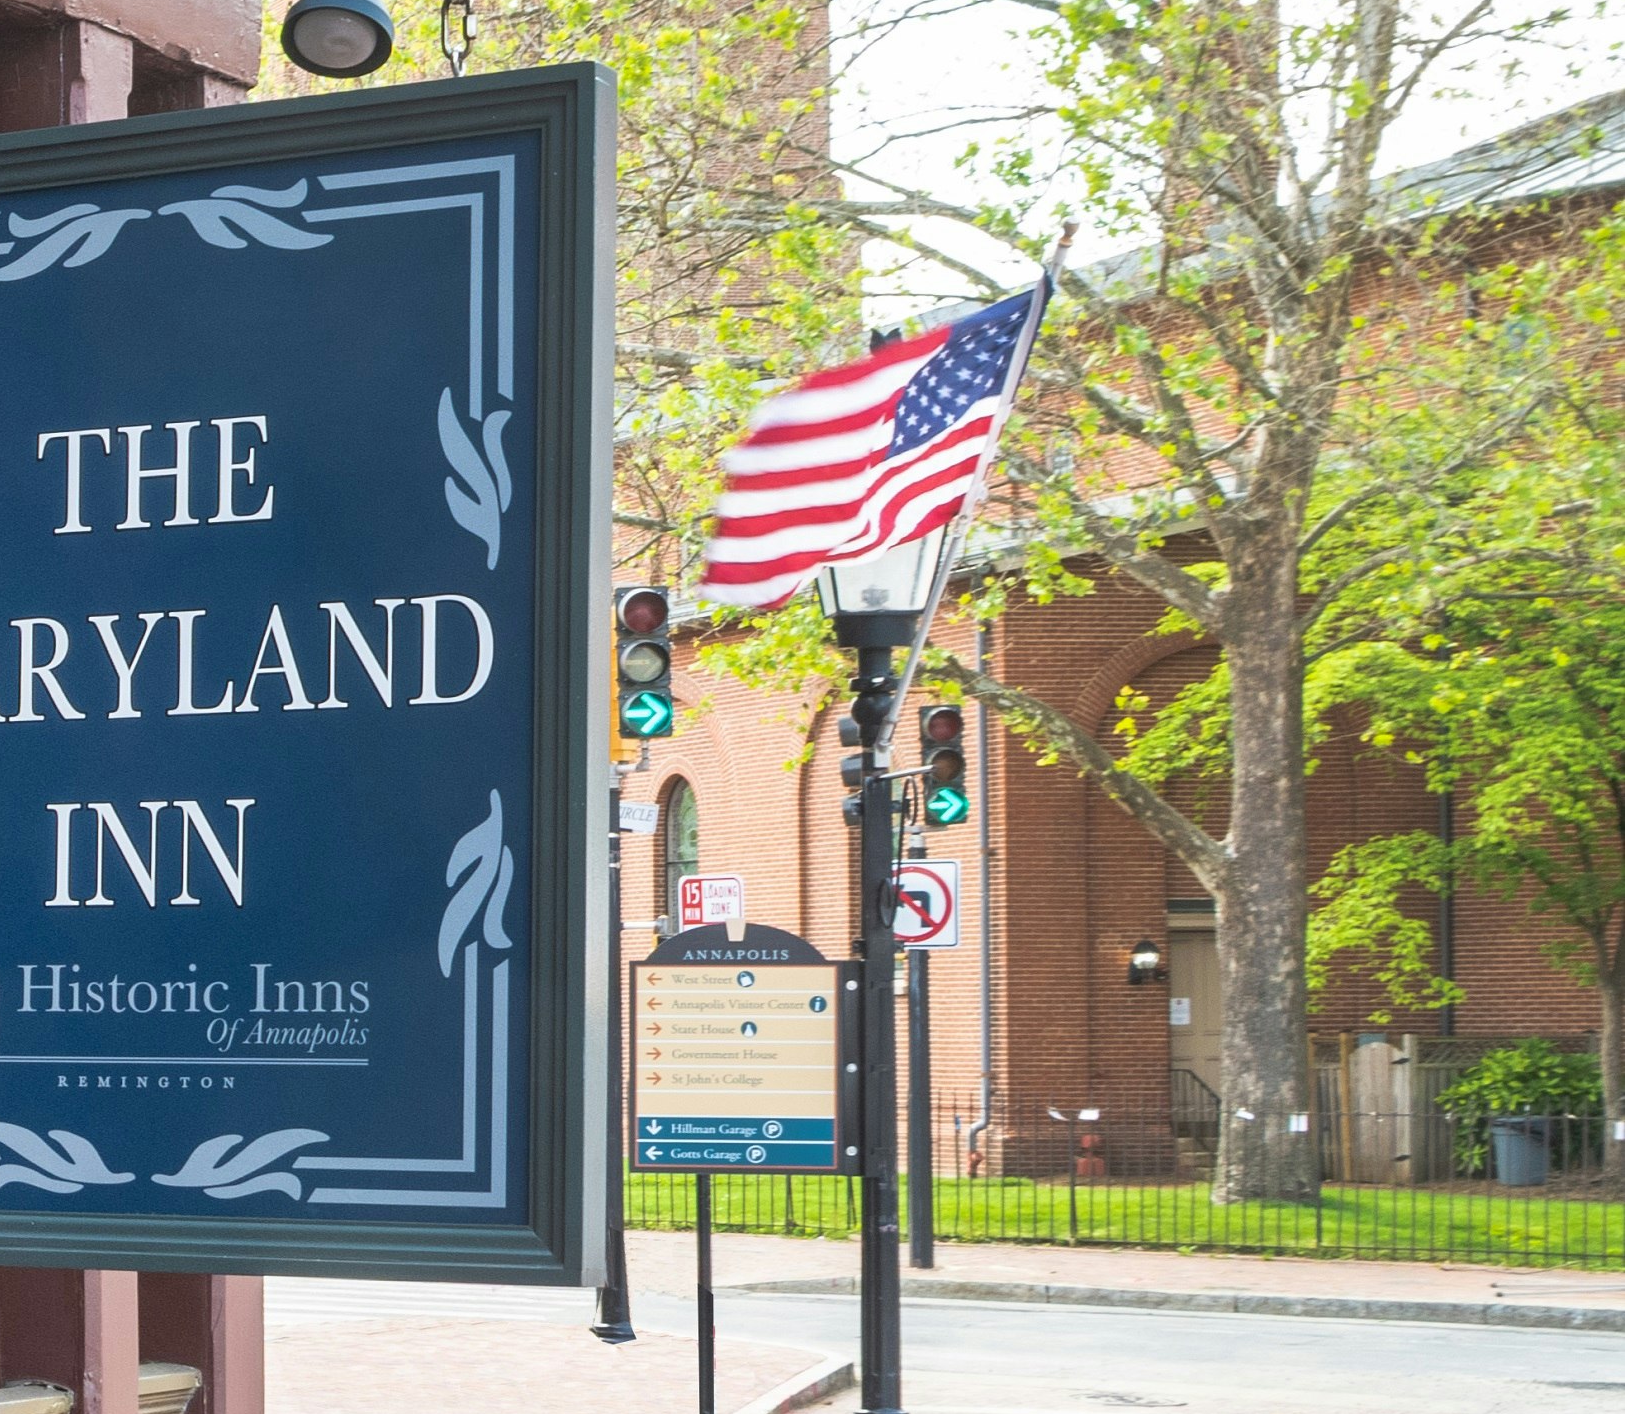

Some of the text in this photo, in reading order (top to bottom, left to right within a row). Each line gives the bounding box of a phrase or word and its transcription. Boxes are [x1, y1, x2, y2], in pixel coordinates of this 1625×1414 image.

[36, 414, 274, 536] THE
[620, 806, 655, 822] IRCLE
[44, 798, 258, 910] INN
[685, 882, 700, 905] 15
[704, 884, 737, 898] LOADING
[710, 902, 731, 915] ZONE
[683, 949, 790, 961] ANNAPOLIS
[671, 974, 733, 985] West Street
[17, 963, 370, 1014] Historic Inns
[671, 999, 725, 1011] Annapolis
[728, 999, 765, 1010] Visitor
[768, 999, 805, 1010] Center
[206, 1017, 370, 1053] Of Annapolis
[671, 1024, 736, 1035] State House
[671, 1048, 778, 1060] Government House
[58, 1075, 235, 1090] REMINGTON
[671, 1074, 763, 1087] St John's College
[671, 1123, 716, 1135] Hillman
[719, 1123, 758, 1137] Garage
[670, 1148, 701, 1160] Gotts
[703, 1148, 742, 1162] Garage
